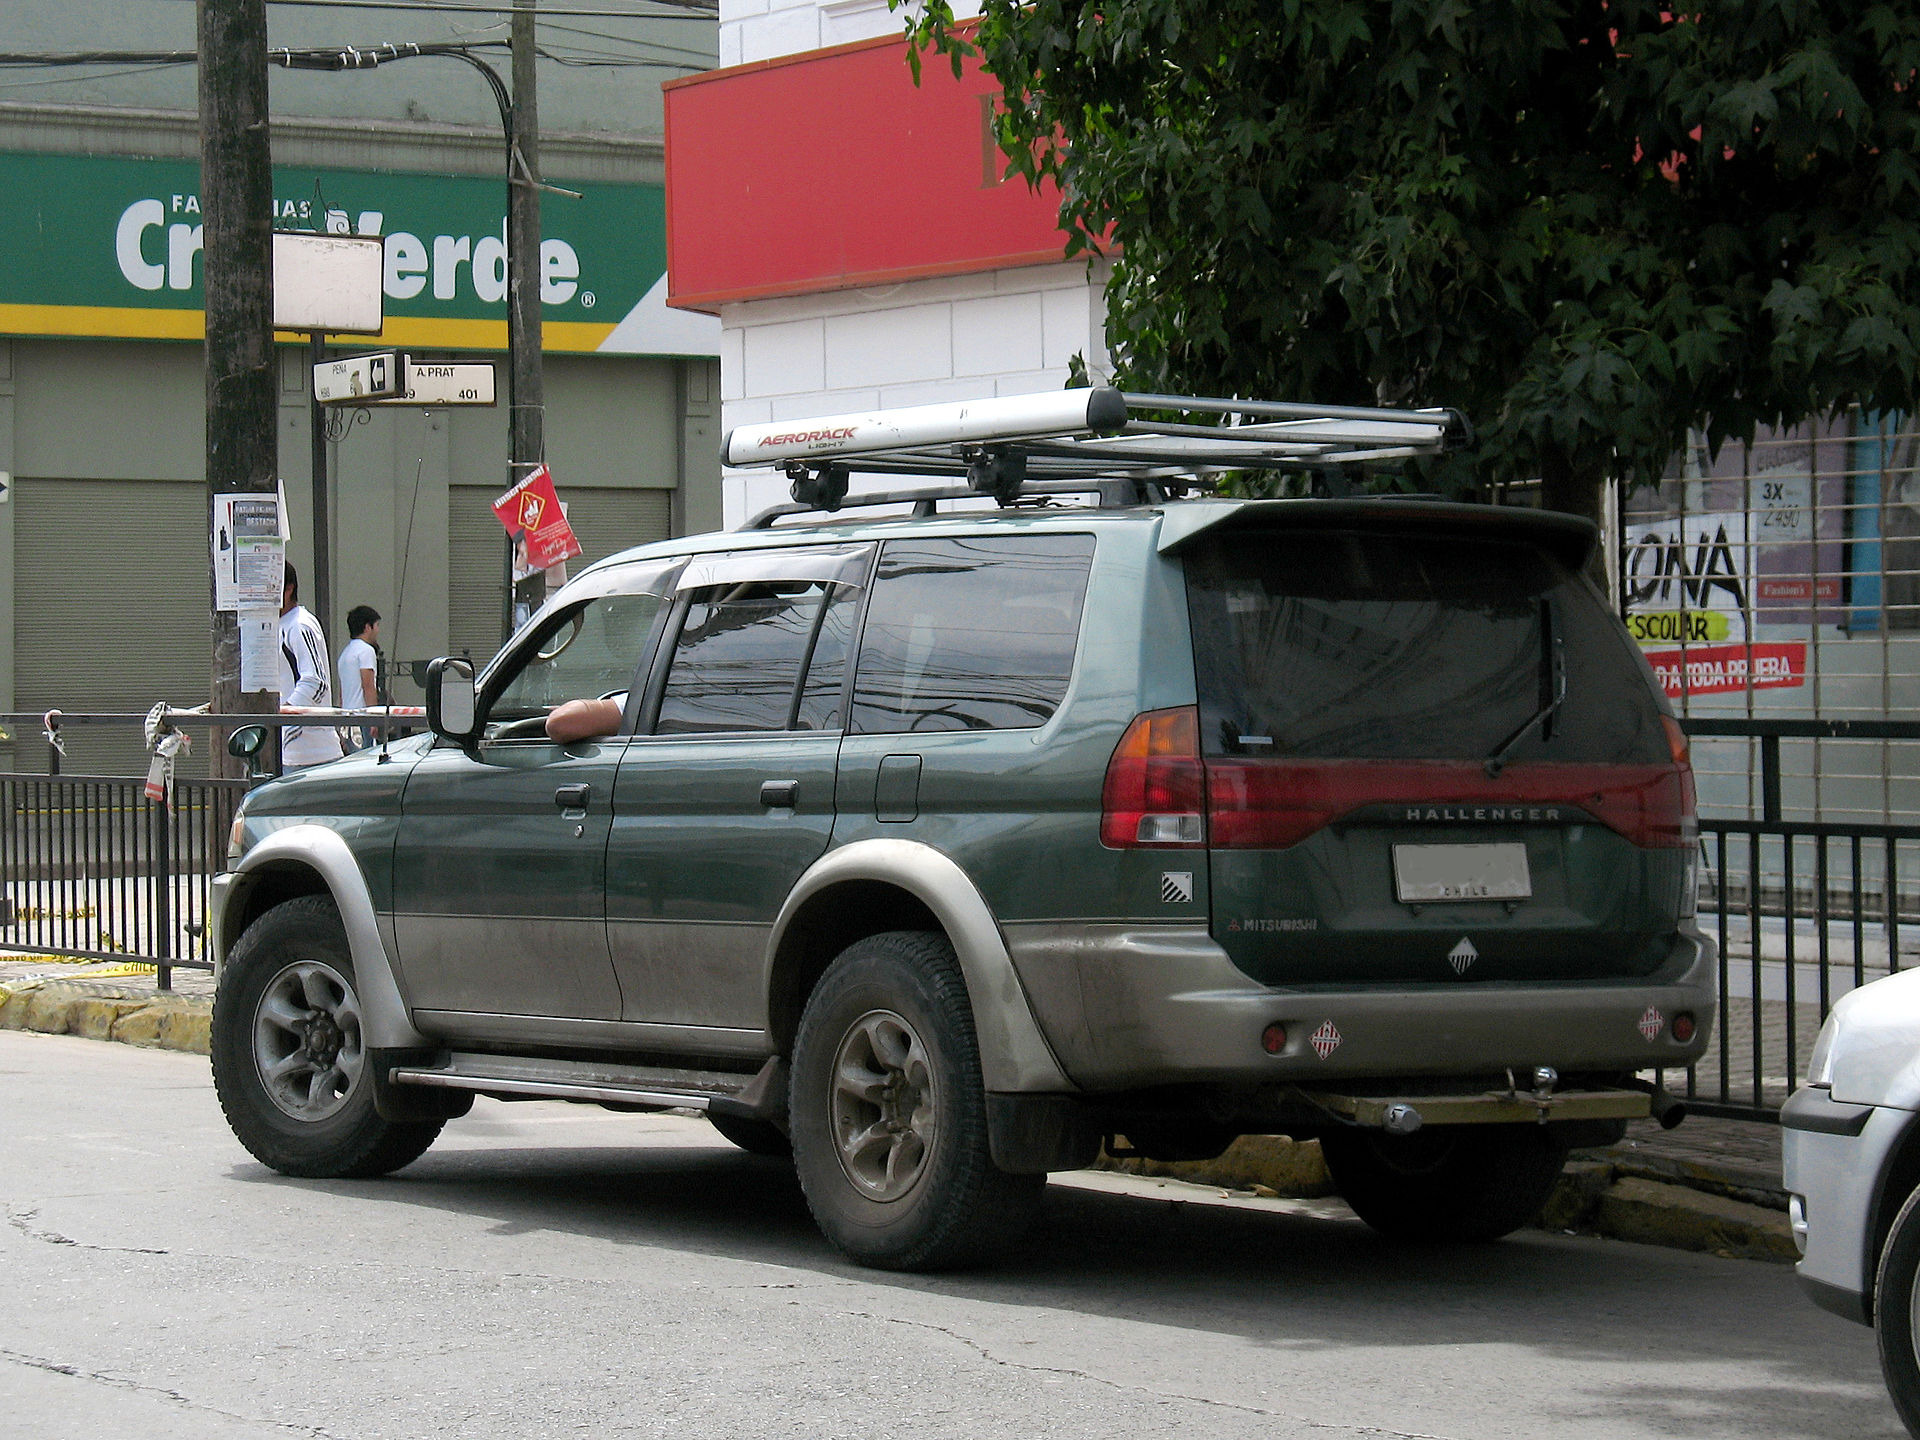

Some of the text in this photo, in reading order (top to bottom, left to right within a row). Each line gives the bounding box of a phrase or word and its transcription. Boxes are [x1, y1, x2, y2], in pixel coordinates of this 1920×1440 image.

[428, 367, 455, 377] PRAT
[458, 389, 478, 399] 401
[758, 427, 858, 447] AERORACK
[1685, 661, 1726, 688] TODA
[1407, 808, 1559, 820] HALLENGER
[1444, 887, 1489, 896] CHILE
[1243, 919, 1318, 931] MITSUBISHI
